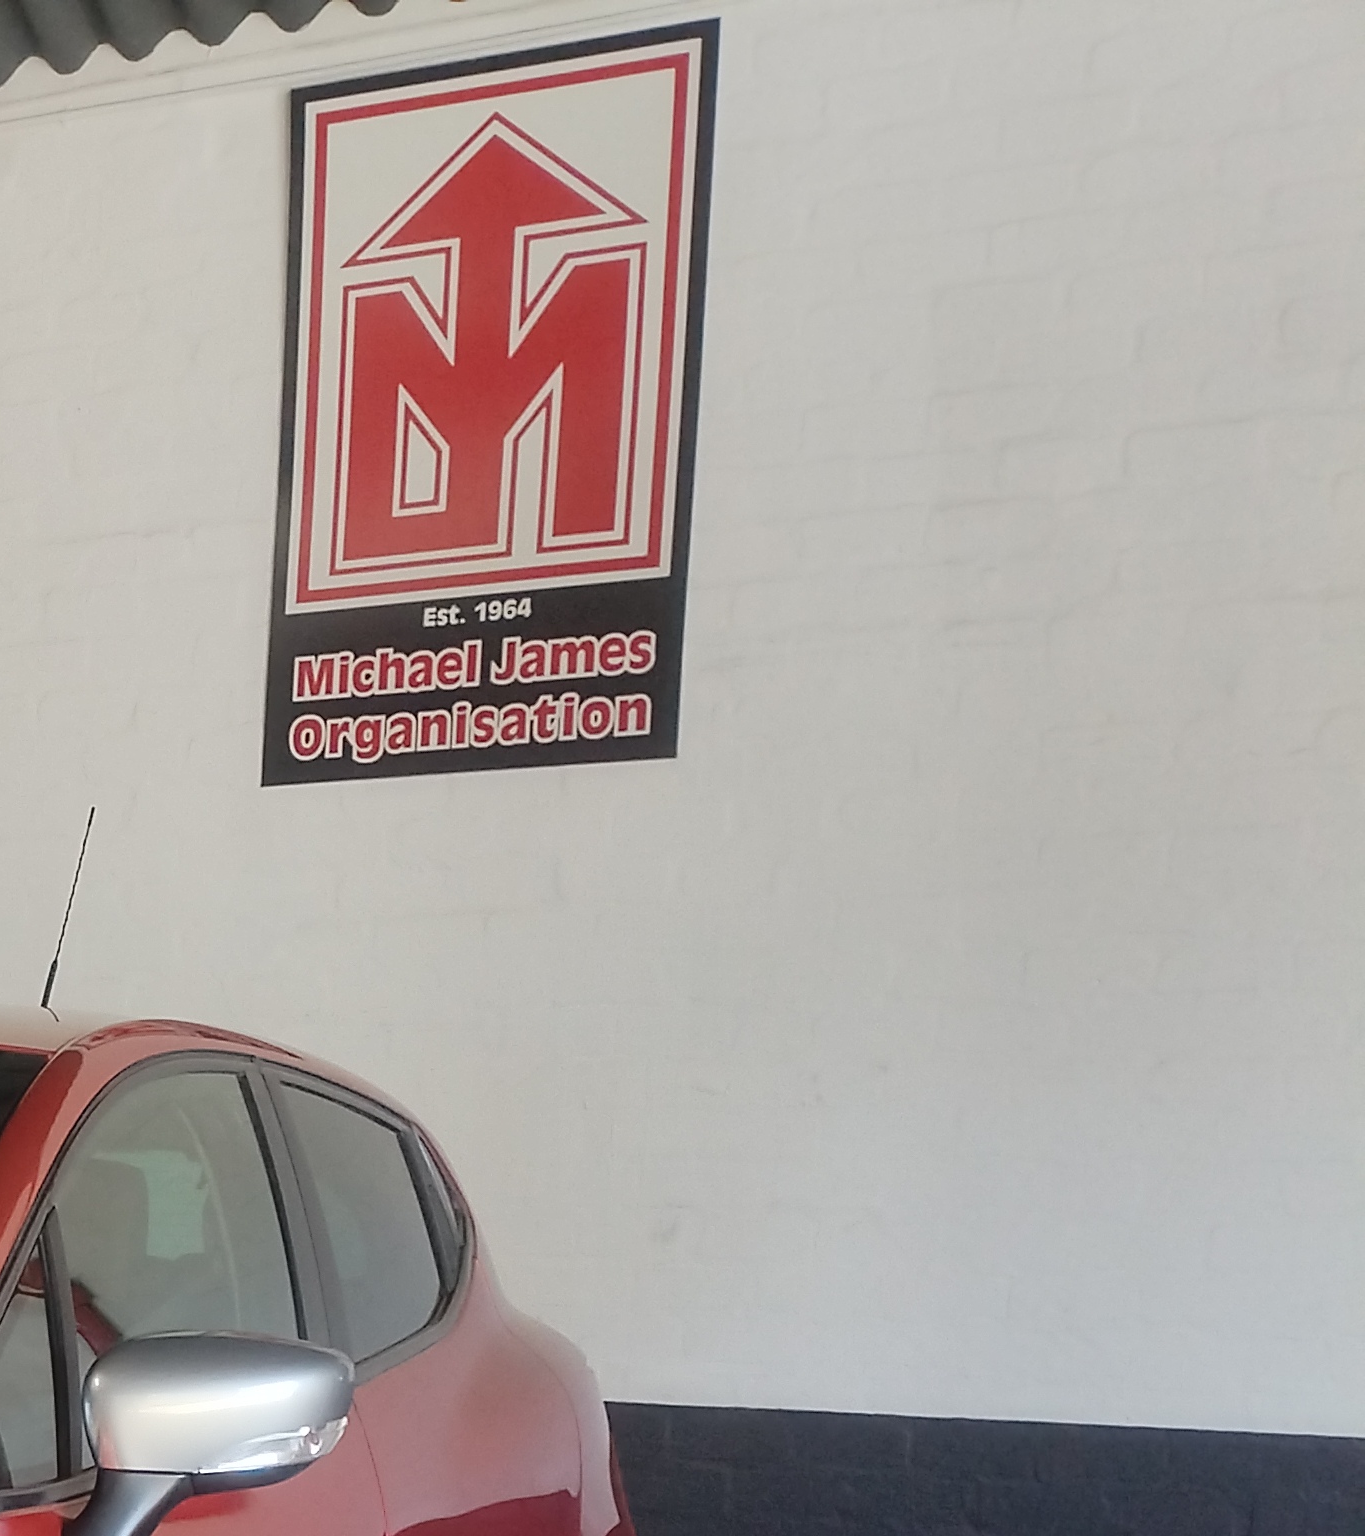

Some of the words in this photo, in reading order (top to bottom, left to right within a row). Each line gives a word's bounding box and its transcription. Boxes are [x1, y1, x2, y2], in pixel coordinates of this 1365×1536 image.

[423, 606, 466, 628] Est.
[474, 597, 533, 623] 1964
[292, 638, 483, 702] Michael
[490, 629, 658, 686] James
[289, 692, 652, 764] Organisation
